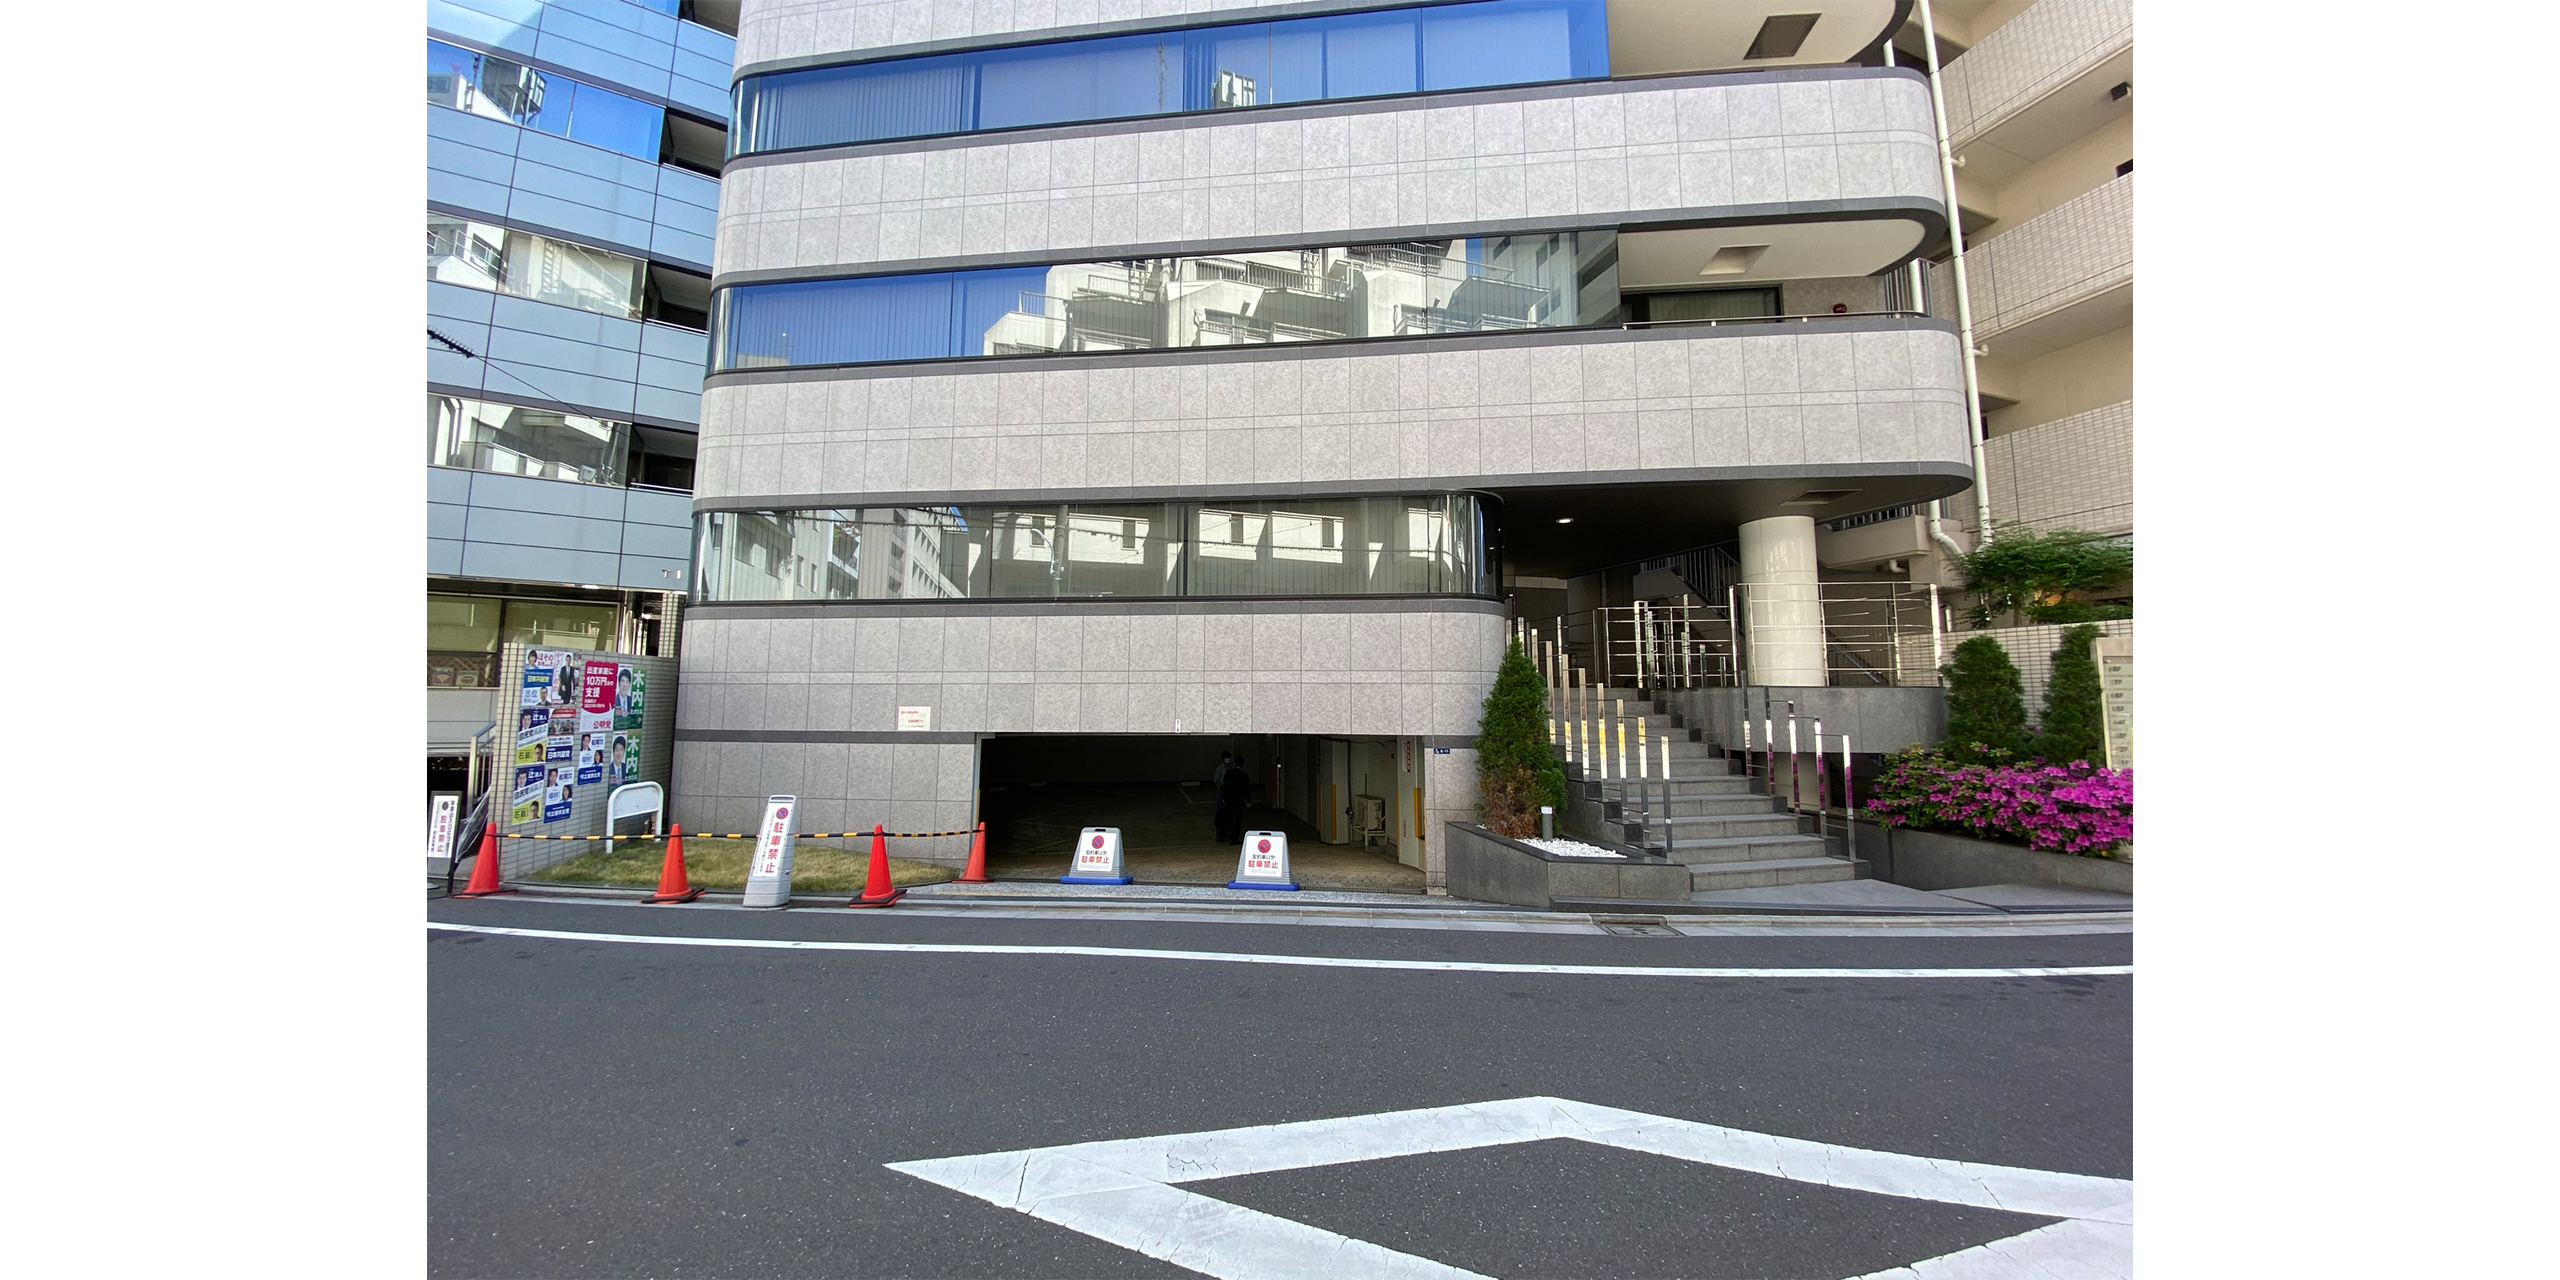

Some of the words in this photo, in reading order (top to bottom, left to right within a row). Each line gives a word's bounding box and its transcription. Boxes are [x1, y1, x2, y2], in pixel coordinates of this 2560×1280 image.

[586, 666, 614, 675] 出産家庭に
[585, 687, 600, 697] 支援
[632, 670, 645, 707] 木内
[593, 720, 612, 729] 公明党
[626, 735, 640, 773] 木内
[764, 822, 784, 873] 駐車禁止
[1081, 856, 1110, 864] 駐車禁止
[1248, 860, 1279, 869] 駐車禁止
